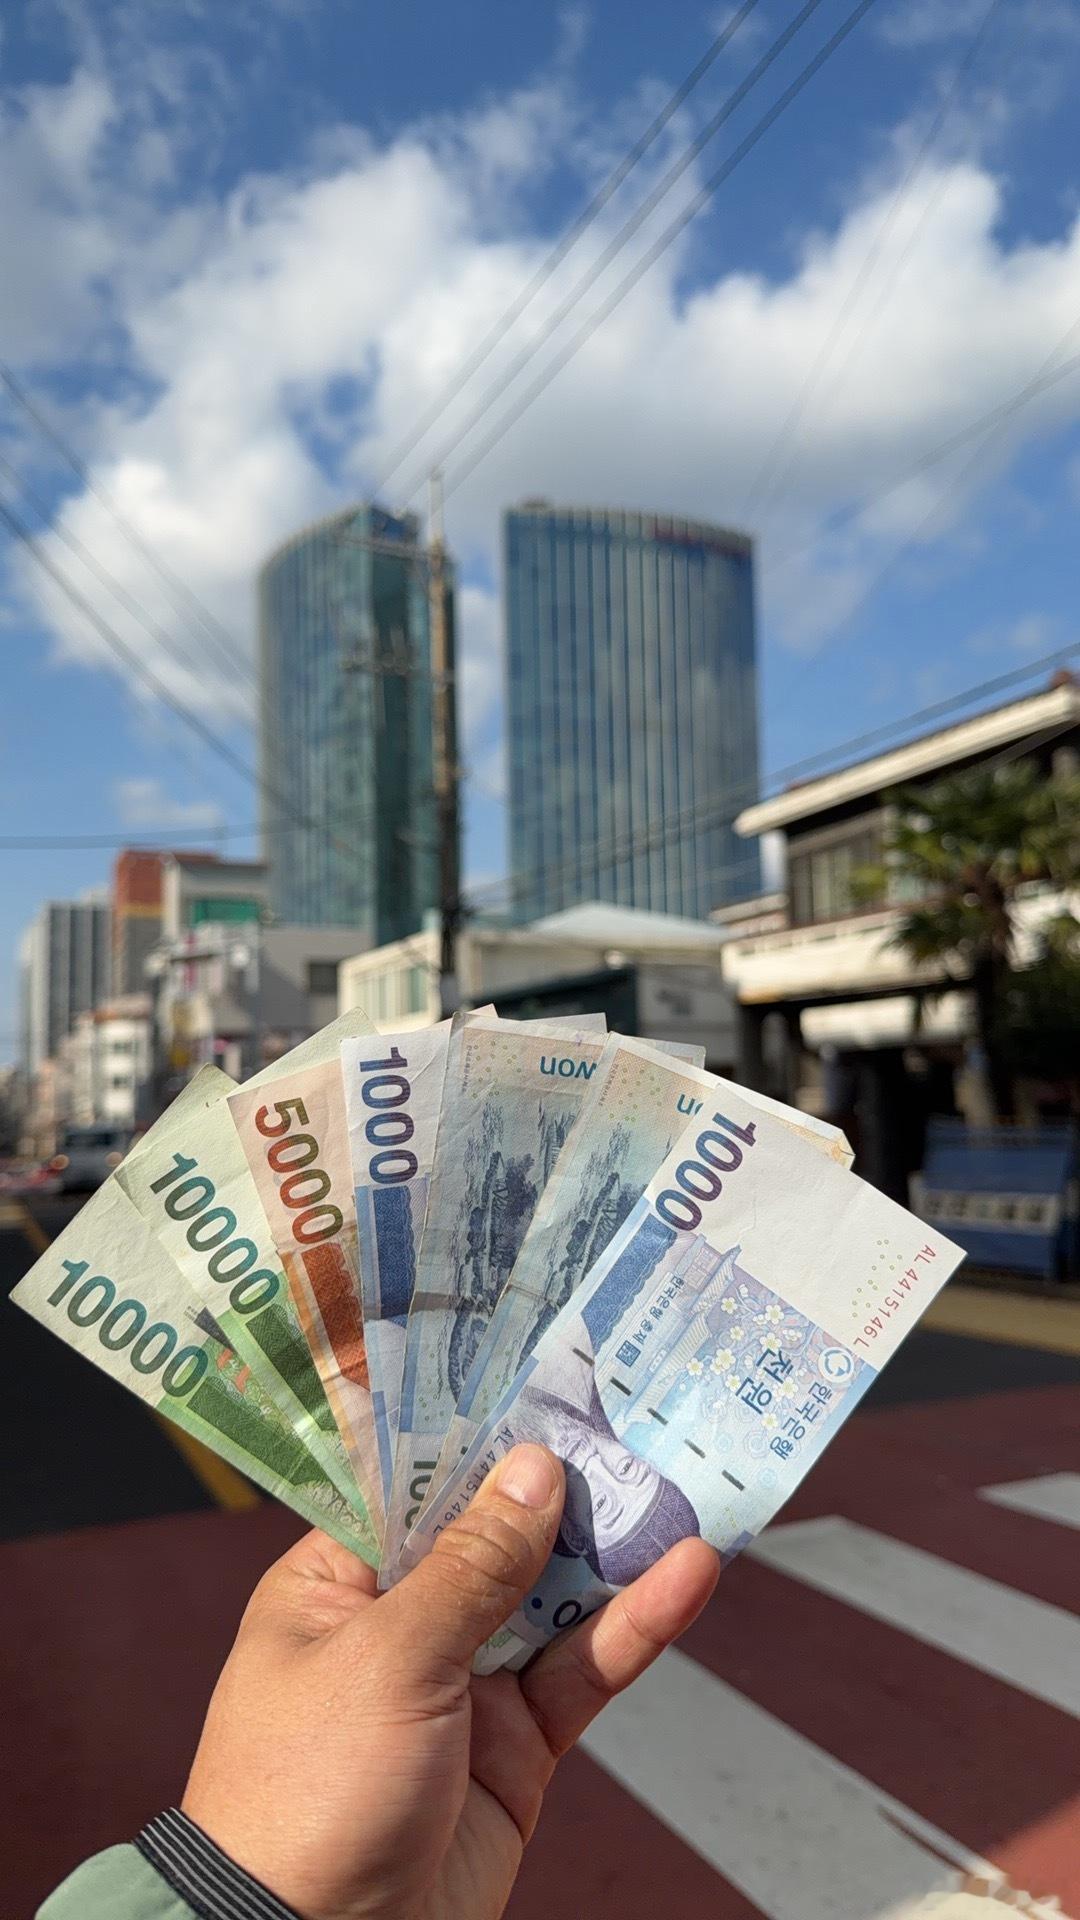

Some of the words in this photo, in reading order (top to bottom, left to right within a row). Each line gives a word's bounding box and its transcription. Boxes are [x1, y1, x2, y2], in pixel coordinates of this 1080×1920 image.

[360, 1047, 418, 1184] 1000
[255, 1097, 344, 1244] 5000
[655, 1112, 757, 1231] 1000
[150, 1152, 280, 1315] 10000
[914, 1244, 936, 1264] AL
[47, 1259, 208, 1397] 10000
[649, 1275, 685, 1320] 한국은행
[863, 1268, 919, 1338] 4415146
[853, 1337, 870, 1348] L
[493, 1426, 514, 1445] AL
[769, 1382, 833, 1460] 한국은행
[444, 1450, 497, 1522] 4415146
